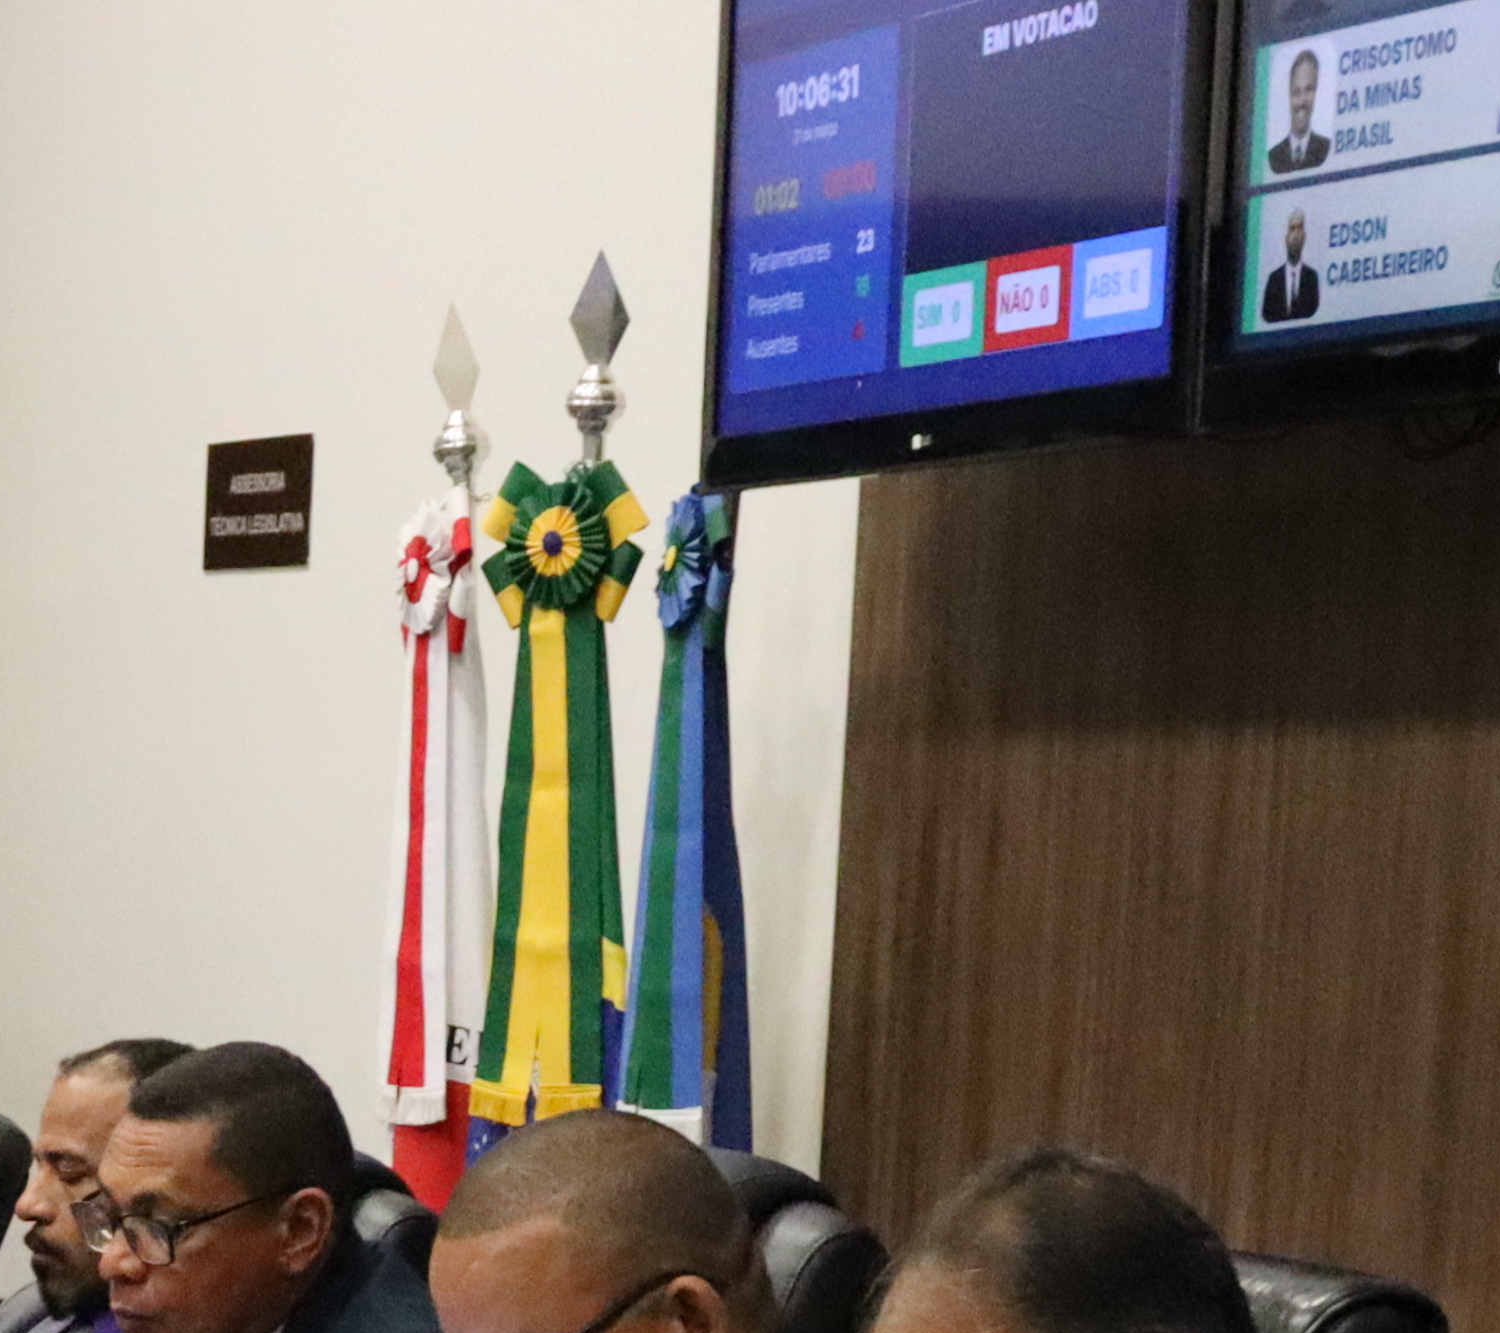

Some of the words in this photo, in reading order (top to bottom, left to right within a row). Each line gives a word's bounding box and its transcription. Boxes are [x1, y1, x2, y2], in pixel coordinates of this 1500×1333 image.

[982, 22, 1010, 56] EM
[1338, 27, 1457, 76] CRISOSTOMO
[775, 63, 860, 117] 10:06:31
[1336, 88, 1360, 115] DA
[1364, 74, 1422, 109] MINAS
[1334, 120, 1393, 153] BRASIL
[855, 228, 875, 254] 23
[1328, 214, 1388, 248] EDSON
[1326, 245, 1449, 286] CABELEIREIRO
[999, 283, 1034, 315] NÃO
[1039, 284, 1050, 309] 0
